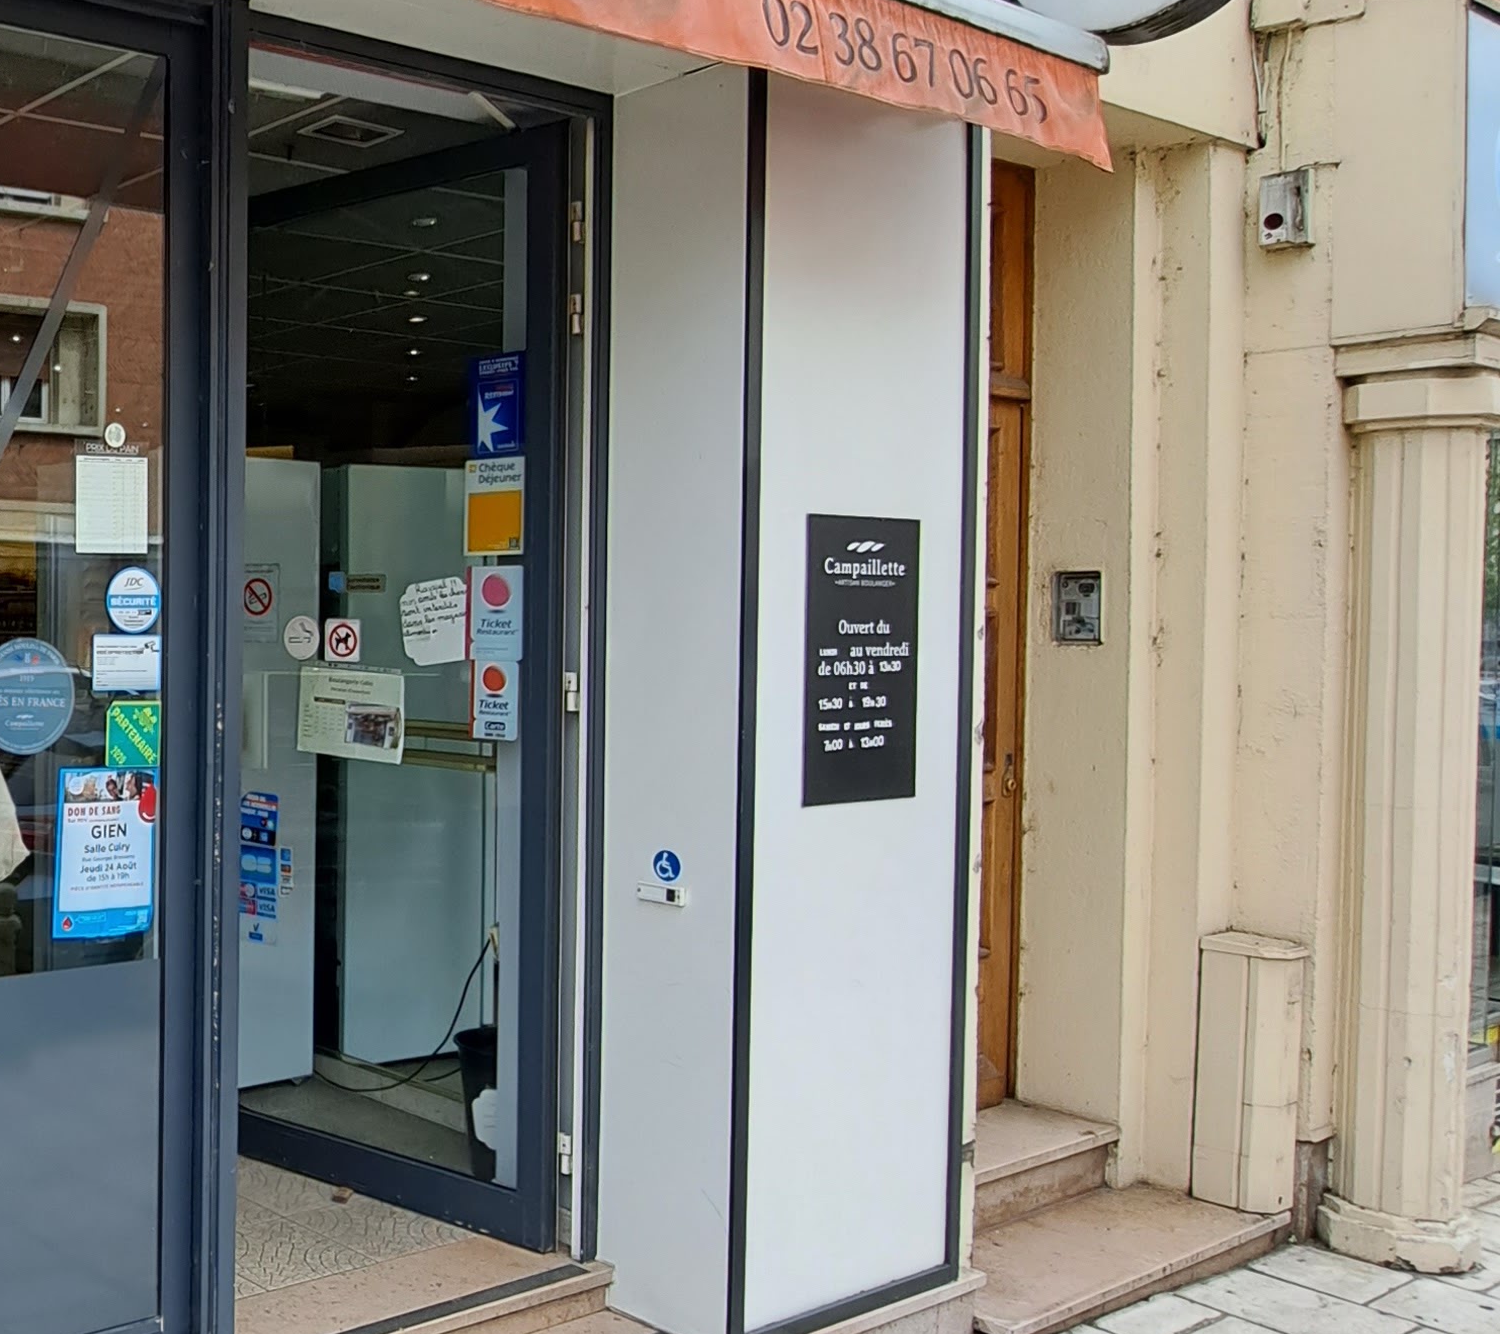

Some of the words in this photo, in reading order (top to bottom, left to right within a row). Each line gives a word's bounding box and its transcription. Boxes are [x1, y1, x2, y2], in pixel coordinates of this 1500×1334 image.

[829, 12, 882, 72] 38
[891, 33, 935, 88] 67
[948, 49, 998, 106] 06
[1005, 69, 1048, 124] 65
[478, 462, 516, 474] Chèque
[478, 473, 522, 486] Déjeuner
[824, 557, 906, 579] Campaillette
[124, 577, 144, 587] JDC
[110, 595, 157, 606] SÉCURITÉ
[480, 618, 512, 629] Ticket
[838, 619, 874, 634] Ouvert
[876, 619, 891, 634] du
[850, 646, 863, 657] au
[865, 641, 910, 657] vendredi
[818, 661, 831, 676] de
[833, 661, 866, 675] 06h30
[11, 696, 25, 707] EN
[27, 697, 66, 708] FRANCE
[479, 699, 509, 710] Ticket
[110, 706, 157, 764] PARTENAIRE
[68, 807, 86, 817] DON
[89, 806, 99, 816] DE
[102, 805, 121, 816] SANG
[91, 823, 127, 839] GIEN
[84, 844, 106, 854] Salle
[80, 863, 103, 874] Jeudi
[105, 863, 114, 872] 24
[116, 861, 137, 871] Août
[259, 887, 275, 896] VISA
[259, 903, 275, 913] VISA
